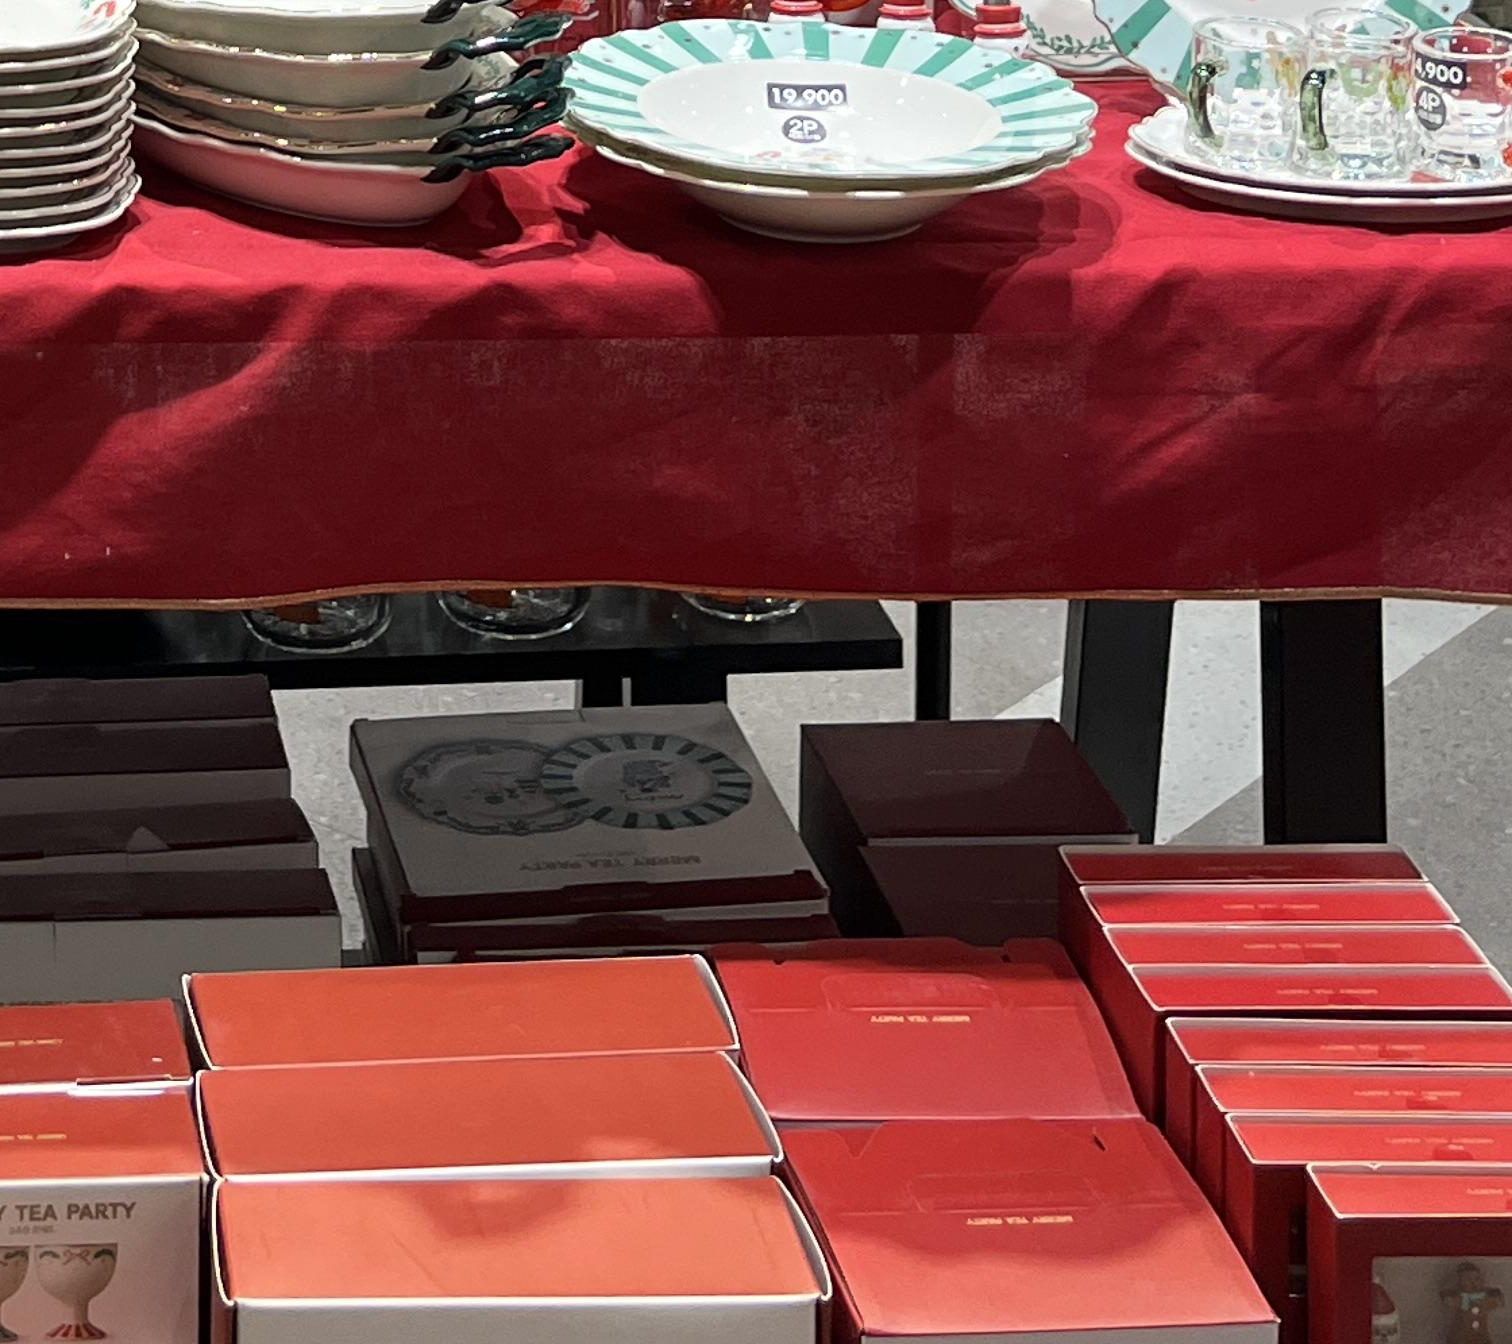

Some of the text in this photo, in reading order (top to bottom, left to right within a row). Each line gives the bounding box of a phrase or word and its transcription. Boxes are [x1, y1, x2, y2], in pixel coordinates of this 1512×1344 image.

[1419, 91, 1441, 112] 4P
[789, 119, 818, 134] 2P
[15, 1204, 58, 1222] TEA
[67, 1201, 136, 1221] PARTY
